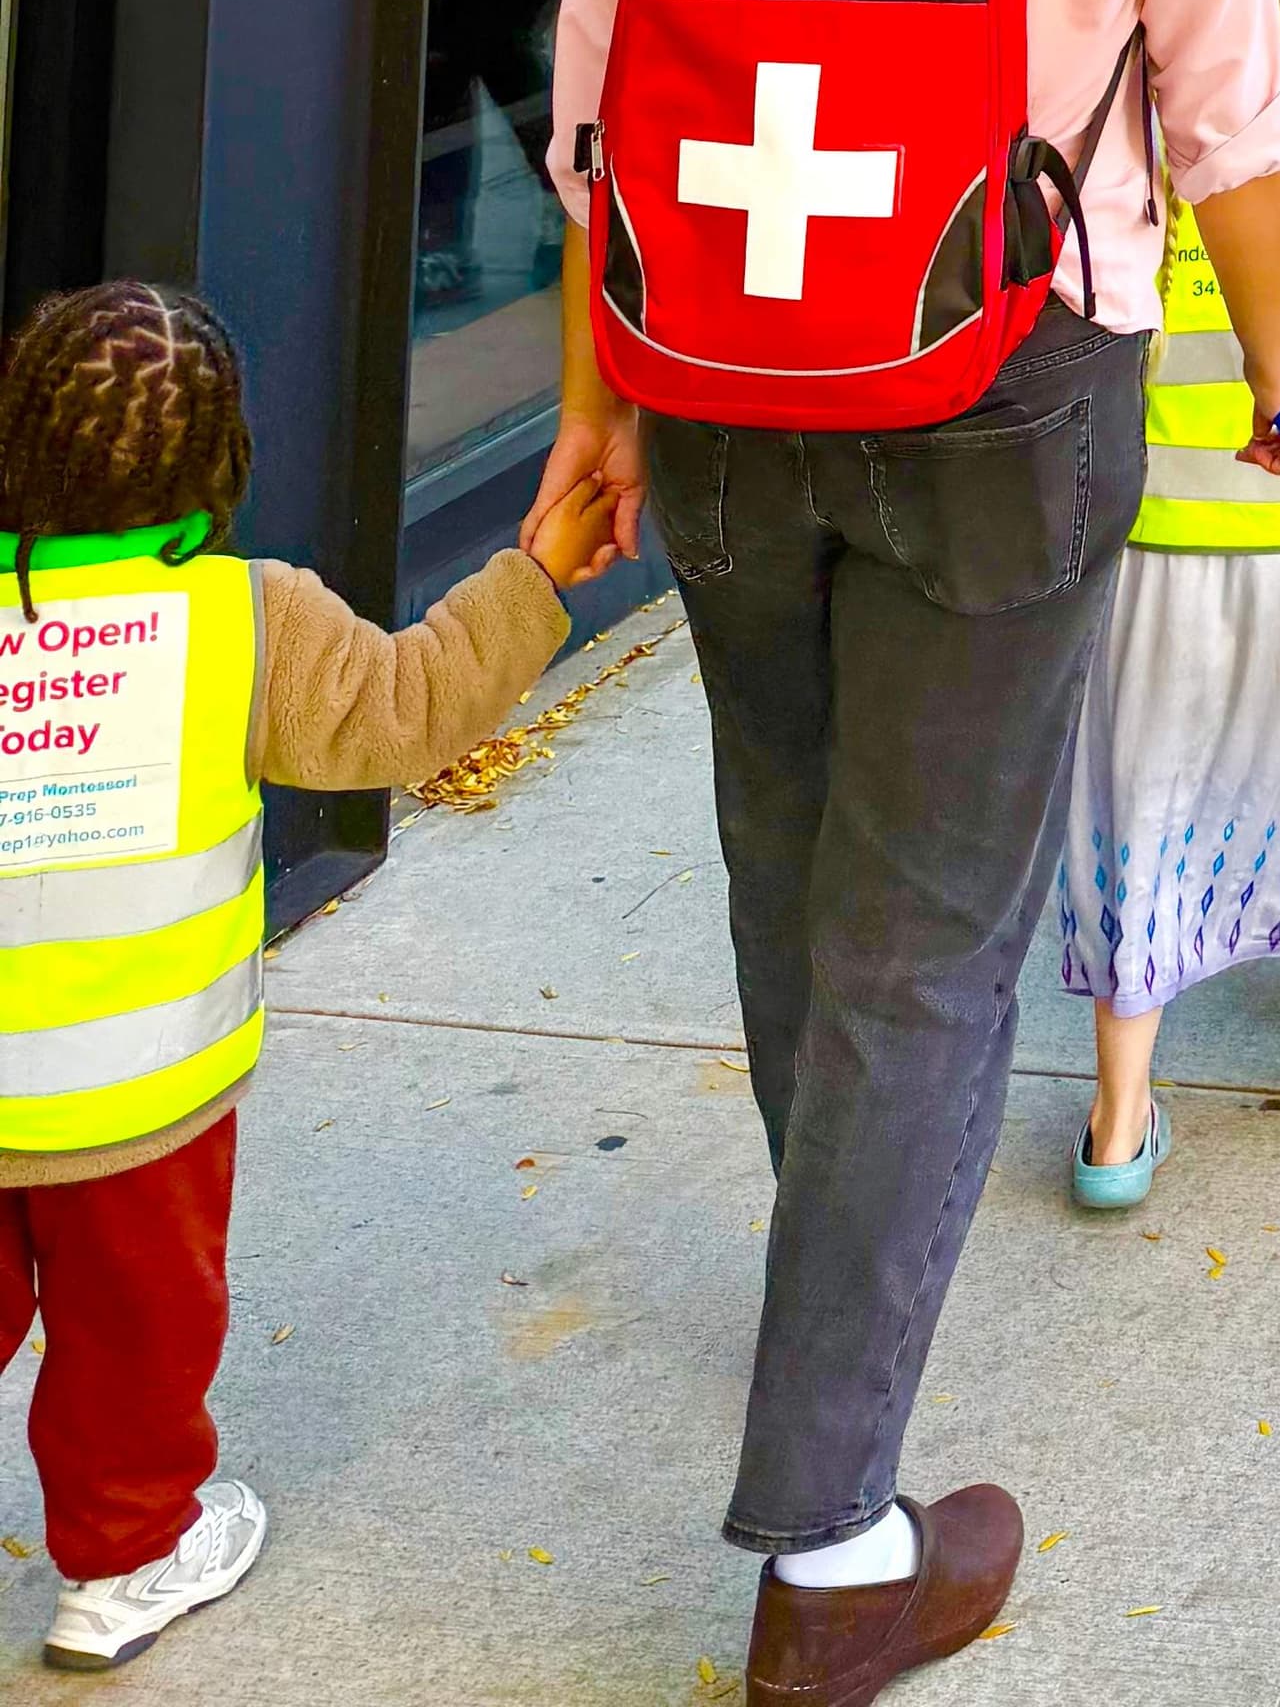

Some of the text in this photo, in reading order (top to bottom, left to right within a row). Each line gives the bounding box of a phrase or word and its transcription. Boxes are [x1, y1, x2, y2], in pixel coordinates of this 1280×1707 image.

[38, 611, 159, 657] Open!
[0, 720, 100, 755] oday
[43, 775, 138, 797] Montessori
